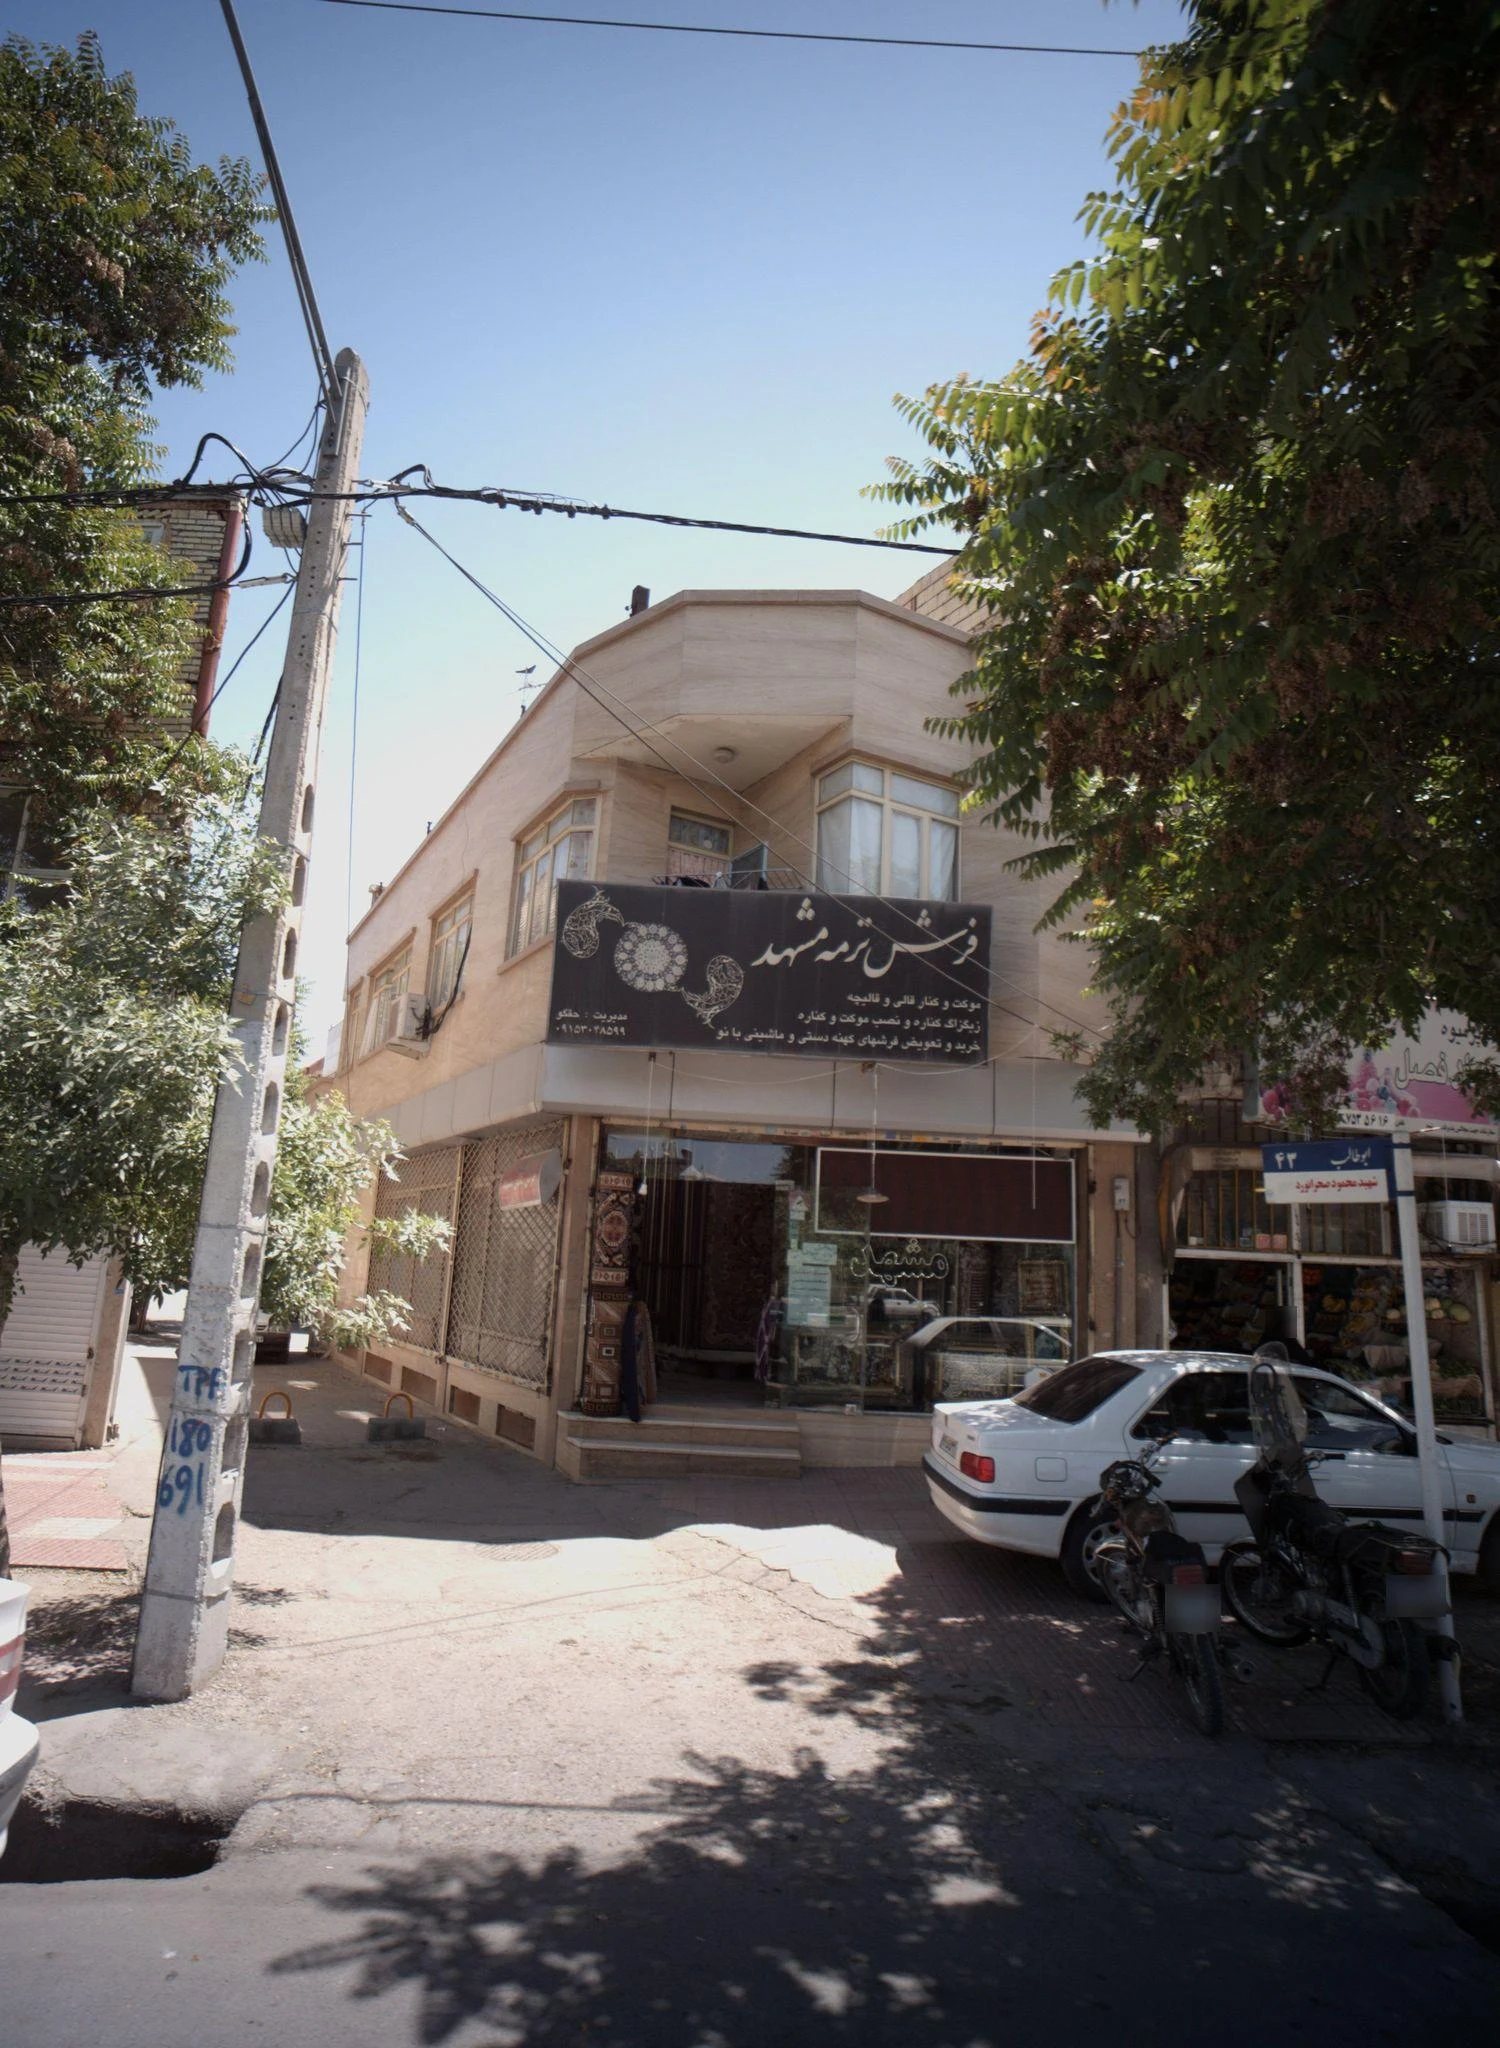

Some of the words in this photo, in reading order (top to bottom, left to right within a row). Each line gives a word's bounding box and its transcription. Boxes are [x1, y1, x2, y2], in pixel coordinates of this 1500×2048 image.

[751, 897, 829, 968] مشهد
[815, 916, 873, 964] ترمه
[863, 908, 978, 979] فرش
[847, 992, 881, 1007] قالیچه
[883, 996, 890, 1007] و
[893, 994, 915, 1009] قالی
[918, 996, 939, 1010] کنار
[942, 1000, 949, 1011] و
[952, 999, 981, 1013] موکت
[592, 1010, 628, 1024] مدیریت
[798, 1010, 826, 1025] کناره
[829, 1014, 837, 1025] و
[839, 1013, 869, 1028] موکت
[872, 1015, 900, 1029] نصب
[904, 1018, 911, 1029] و
[913, 1016, 941, 1031] کناره
[716, 1028, 729, 1040] نو
[731, 1027, 741, 1038] با
[744, 1028, 785, 1043] ماشینی
[788, 1033, 795, 1043] و
[799, 1031, 829, 1045] دستی
[832, 1033, 855, 1046] کهنه
[901, 1036, 942, 1051] تعویض
[945, 1042, 952, 1052] و
[954, 1040, 981, 1054] خرید
[1275, 1152, 1297, 1170] ۴۳
[1330, 1144, 1371, 1170] ابوطالب
[1331, 1179, 1357, 1192] محمود
[1358, 1176, 1378, 1191] شهید
[178, 1365, 226, 1401] TPF
[171, 1417, 212, 1458] 180
[158, 1462, 206, 1516] 691
